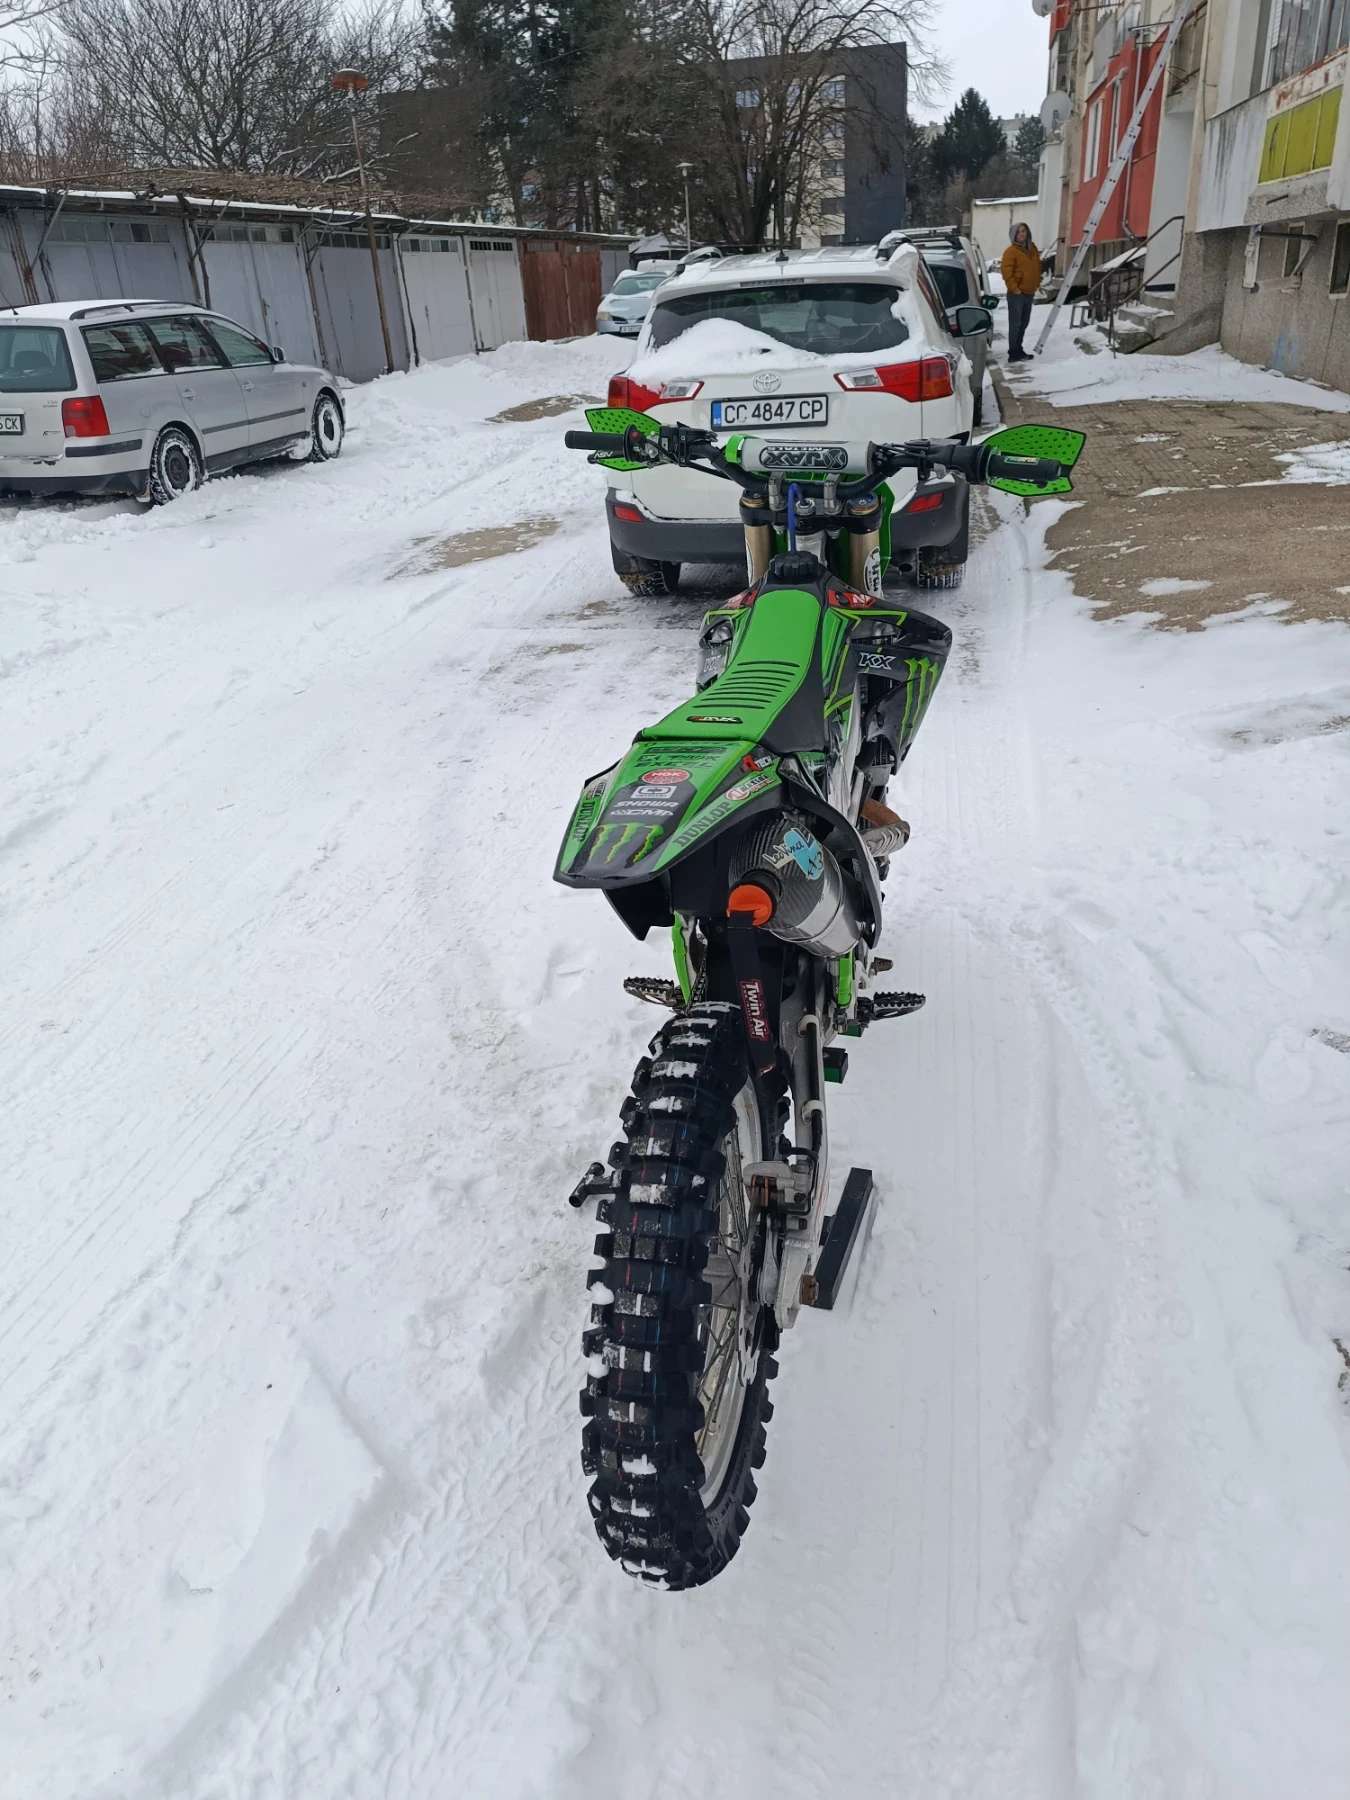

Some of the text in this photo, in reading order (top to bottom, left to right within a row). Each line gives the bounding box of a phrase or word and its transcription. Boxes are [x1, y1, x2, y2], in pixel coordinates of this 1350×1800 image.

[724, 400, 823, 424] CC 4847 CP
[4, 417, 19, 430] CK
[761, 451, 824, 467] JAX
[859, 652, 897, 670] KX
[613, 800, 680, 808] SHOWA
[672, 801, 733, 848] DUNLOP
[746, 981, 762, 1017] Twin
[752, 1017, 767, 1039] Air
